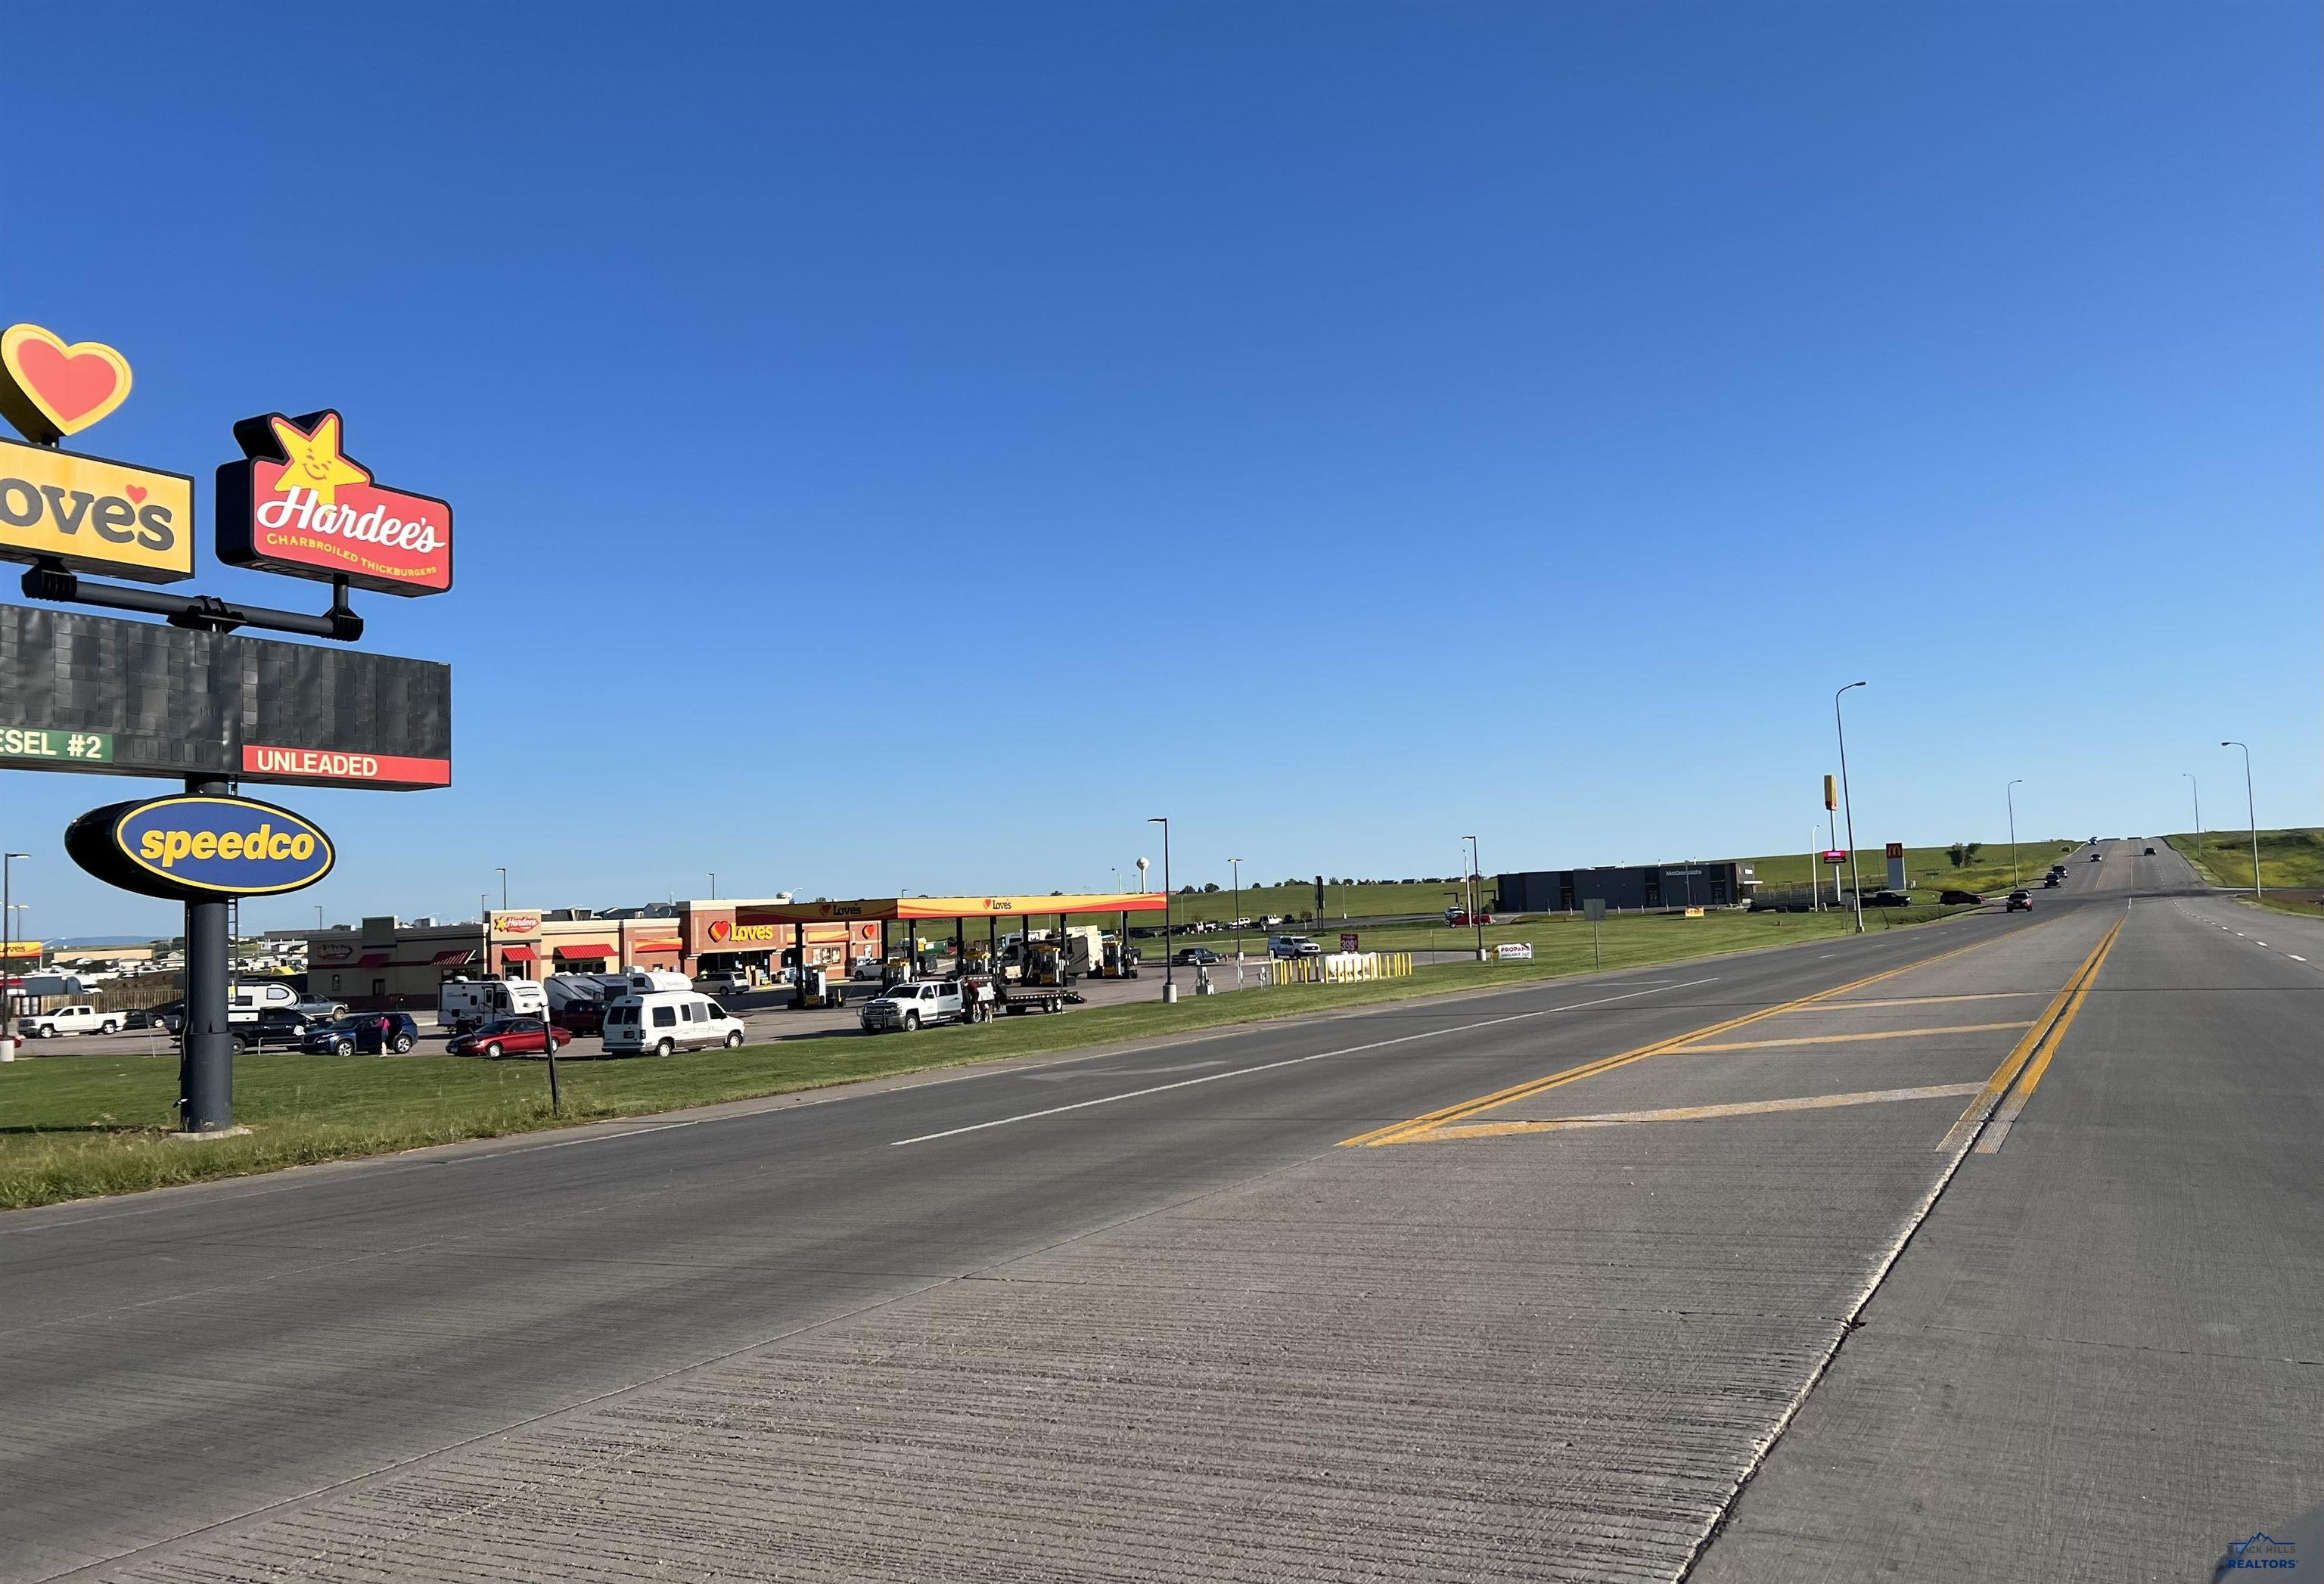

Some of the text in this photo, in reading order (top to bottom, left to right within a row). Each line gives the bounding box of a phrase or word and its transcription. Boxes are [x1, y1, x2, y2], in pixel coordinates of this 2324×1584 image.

[256, 485, 446, 553] Hardee's
[266, 533, 437, 576] CHARBROILED THICKBURGERS
[67, 734, 102, 759] #2
[257, 750, 377, 777] UNLEADED
[140, 824, 315, 867] speedco
